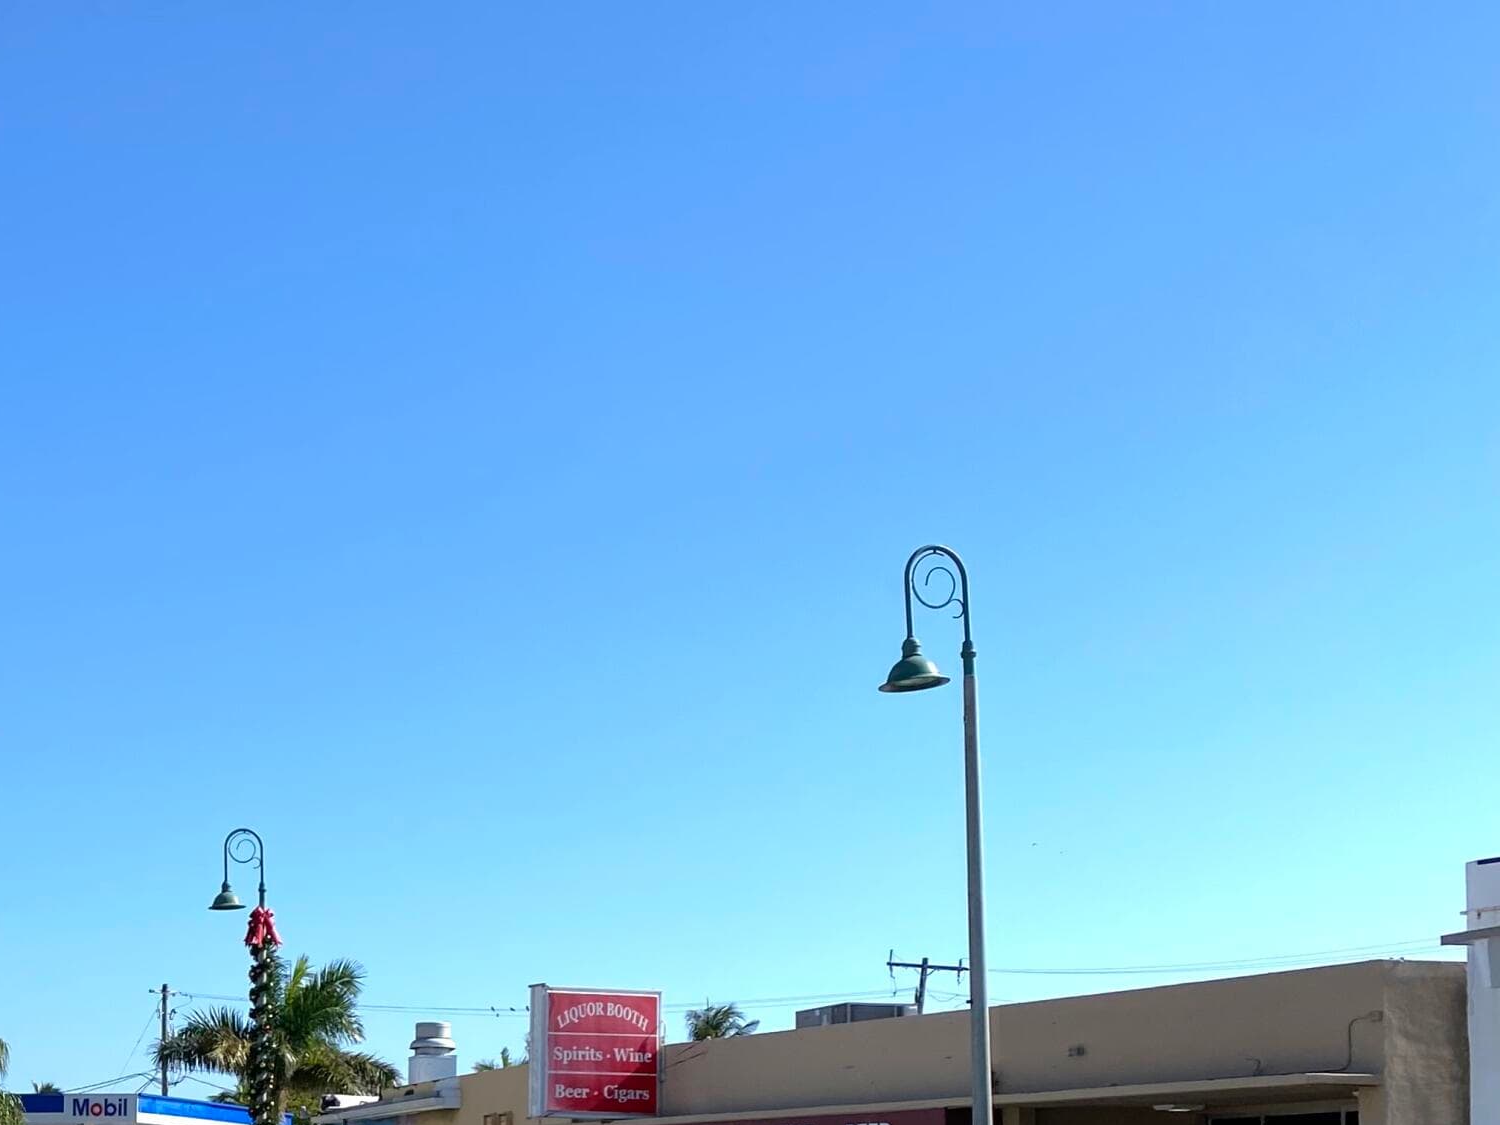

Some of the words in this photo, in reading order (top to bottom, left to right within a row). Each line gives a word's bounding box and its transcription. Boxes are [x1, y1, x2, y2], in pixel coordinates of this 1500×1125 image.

[557, 1002, 605, 1028] LIQUOR
[607, 1002, 649, 1032] BOOTH
[553, 1046, 603, 1064] Spirits
[613, 1047, 652, 1063] Wine
[555, 1084, 590, 1098] Beer
[603, 1084, 650, 1103] Cigars
[72, 1098, 127, 1117] Mobil
